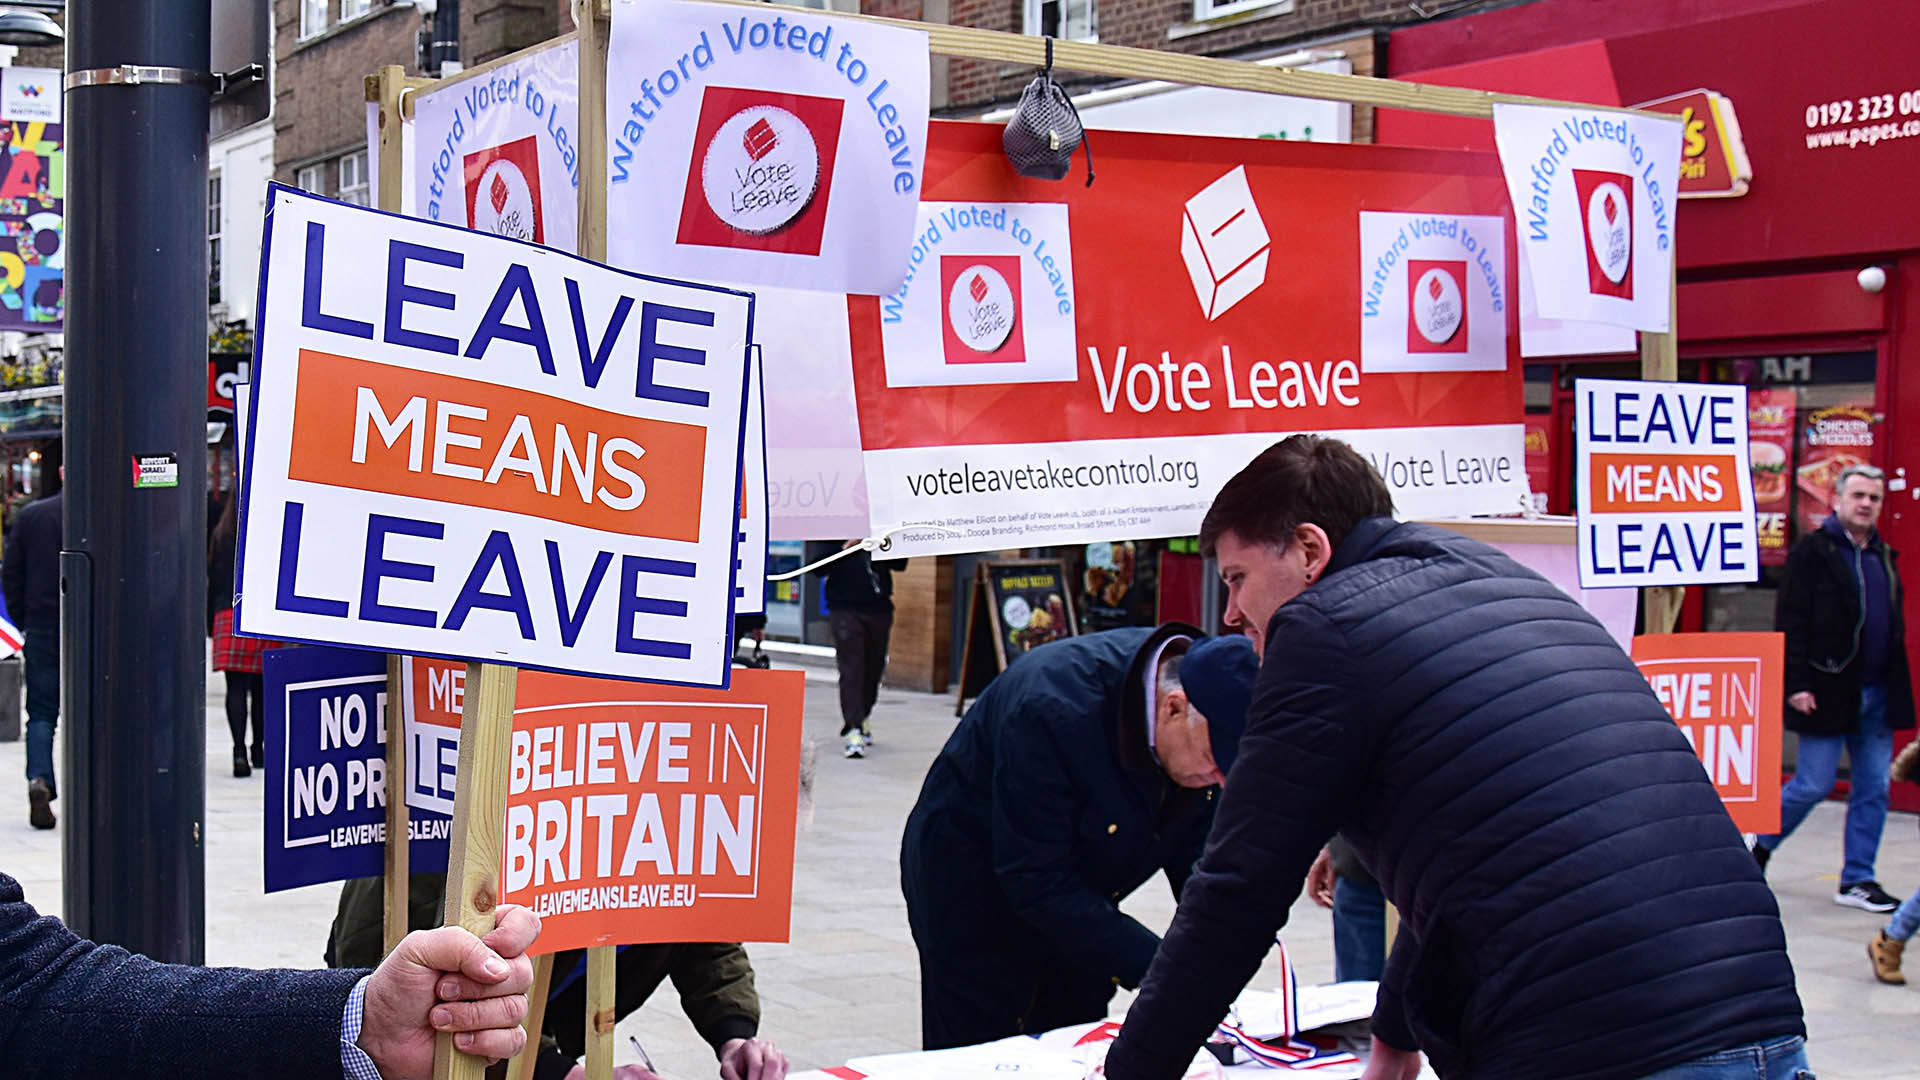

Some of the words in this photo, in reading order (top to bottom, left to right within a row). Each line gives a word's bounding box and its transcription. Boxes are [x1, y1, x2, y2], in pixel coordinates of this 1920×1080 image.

[611, 31, 714, 184] Watford
[722, 17, 832, 60] Voted
[835, 42, 868, 84] to
[867, 79, 915, 195] Leave
[1805, 100, 1853, 128] 0192
[1857, 93, 1894, 121] 323
[428, 108, 465, 220] atford
[465, 69, 520, 120] Voted
[525, 79, 545, 118] to
[547, 104, 579, 189] Lea
[730, 181, 799, 214] Leave
[735, 160, 793, 190] Vote
[1527, 128, 1569, 241] Watford
[1563, 116, 1627, 144] Voted
[1630, 134, 1644, 166] to
[1642, 162, 1670, 251] Leave
[884, 219, 942, 323] Word
[941, 206, 1006, 232] Voted
[1012, 218, 1032, 245] to
[1033, 240, 1071, 315] Leave
[1364, 227, 1409, 317] Watford
[1409, 218, 1458, 239] Voted
[1461, 228, 1477, 252] to
[1477, 248, 1504, 312] Leave
[302, 221, 715, 408] LEAVE
[968, 303, 999, 323] Vote
[969, 315, 1006, 340] Leave
[1088, 346, 1211, 413] Vote
[1222, 345, 1360, 409] Leave
[1588, 391, 1735, 445] LEAVE
[351, 386, 646, 511] MEANS
[1371, 452, 1434, 490] Vote
[1440, 449, 1510, 487] Leave
[907, 455, 1199, 497] voteleavetakecontrol.org
[1606, 464, 1723, 503] MEANS
[903, 532, 936, 542] Produced
[946, 517, 974, 526] Matthew
[976, 515, 996, 524] Elliott
[1008, 512, 1028, 521] behalf
[1591, 522, 1746, 575] LEAVE
[275, 501, 697, 660] LEAVE
[320, 693, 367, 751] NO
[1721, 673, 1756, 718] IN
[509, 722, 691, 795] BELIEVE
[708, 722, 760, 785] IN
[294, 762, 339, 819] NO
[506, 793, 755, 894] BRITAIN
[534, 884, 696, 920] LEAVEMEANSLEAVE.EU
